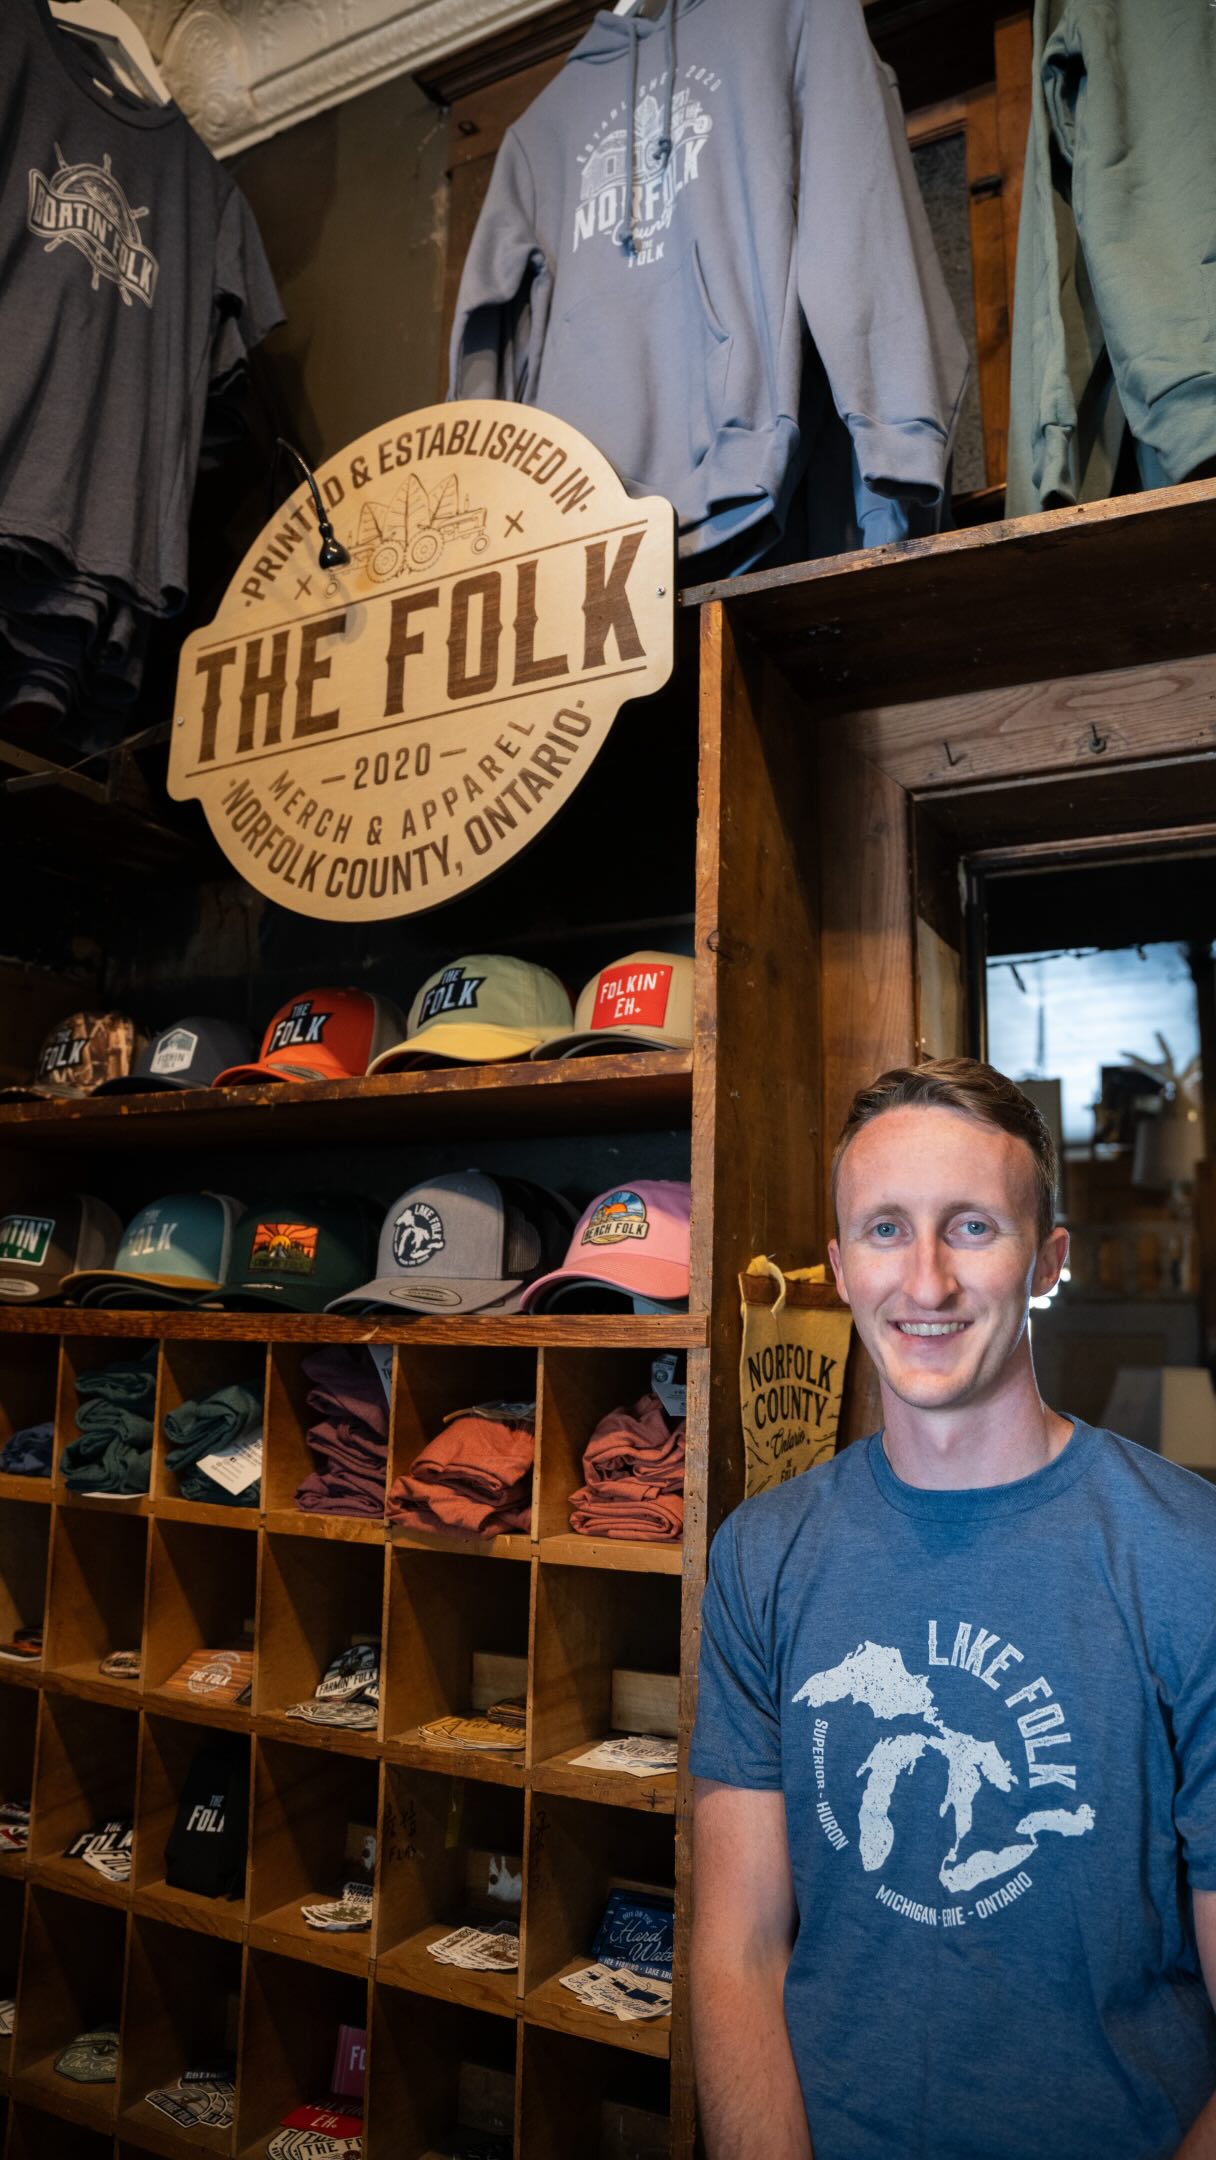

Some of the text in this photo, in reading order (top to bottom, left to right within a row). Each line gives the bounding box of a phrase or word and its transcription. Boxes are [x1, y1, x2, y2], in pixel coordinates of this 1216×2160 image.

[33, 188, 153, 293] BOATIN' FOLK
[350, 455, 373, 490] &
[378, 419, 568, 485] ESTABLISHED
[549, 467, 596, 515] IN
[195, 530, 647, 763] THE FOLK
[268, 720, 536, 846] MERCH & APPAREL
[353, 742, 431, 790] 2020
[221, 707, 592, 900] NORFOLK COUNTY, ONTARIO
[442, 969, 462, 983] THE
[600, 970, 665, 1004] FOLKIN'
[291, 1002, 309, 1017] THE
[419, 979, 480, 1023] FOLK
[613, 997, 642, 1018] EH.
[269, 1015, 327, 1052] FOLK
[41, 1039, 86, 1073] FOLK
[414, 1203, 435, 1221] LAKE
[584, 1222, 645, 1242] BEACH FOLK
[747, 1343, 837, 1393] NORFOLK
[754, 1385, 829, 1430] COUNTY
[319, 1675, 353, 1696] FARMIN'
[354, 1671, 375, 1685] FOLK
[928, 1620, 1076, 1791] LAKE FOLK
[812, 1718, 849, 1851] SUPERIOR HURON
[875, 1871, 1033, 1927] MICHIGAN ERIE ONTARIO
[610, 1918, 668, 1944] Hard
[645, 1966, 660, 1977] LAKE
[661, 1969, 673, 1980] ERI
[303, 2141, 338, 2155] THE
